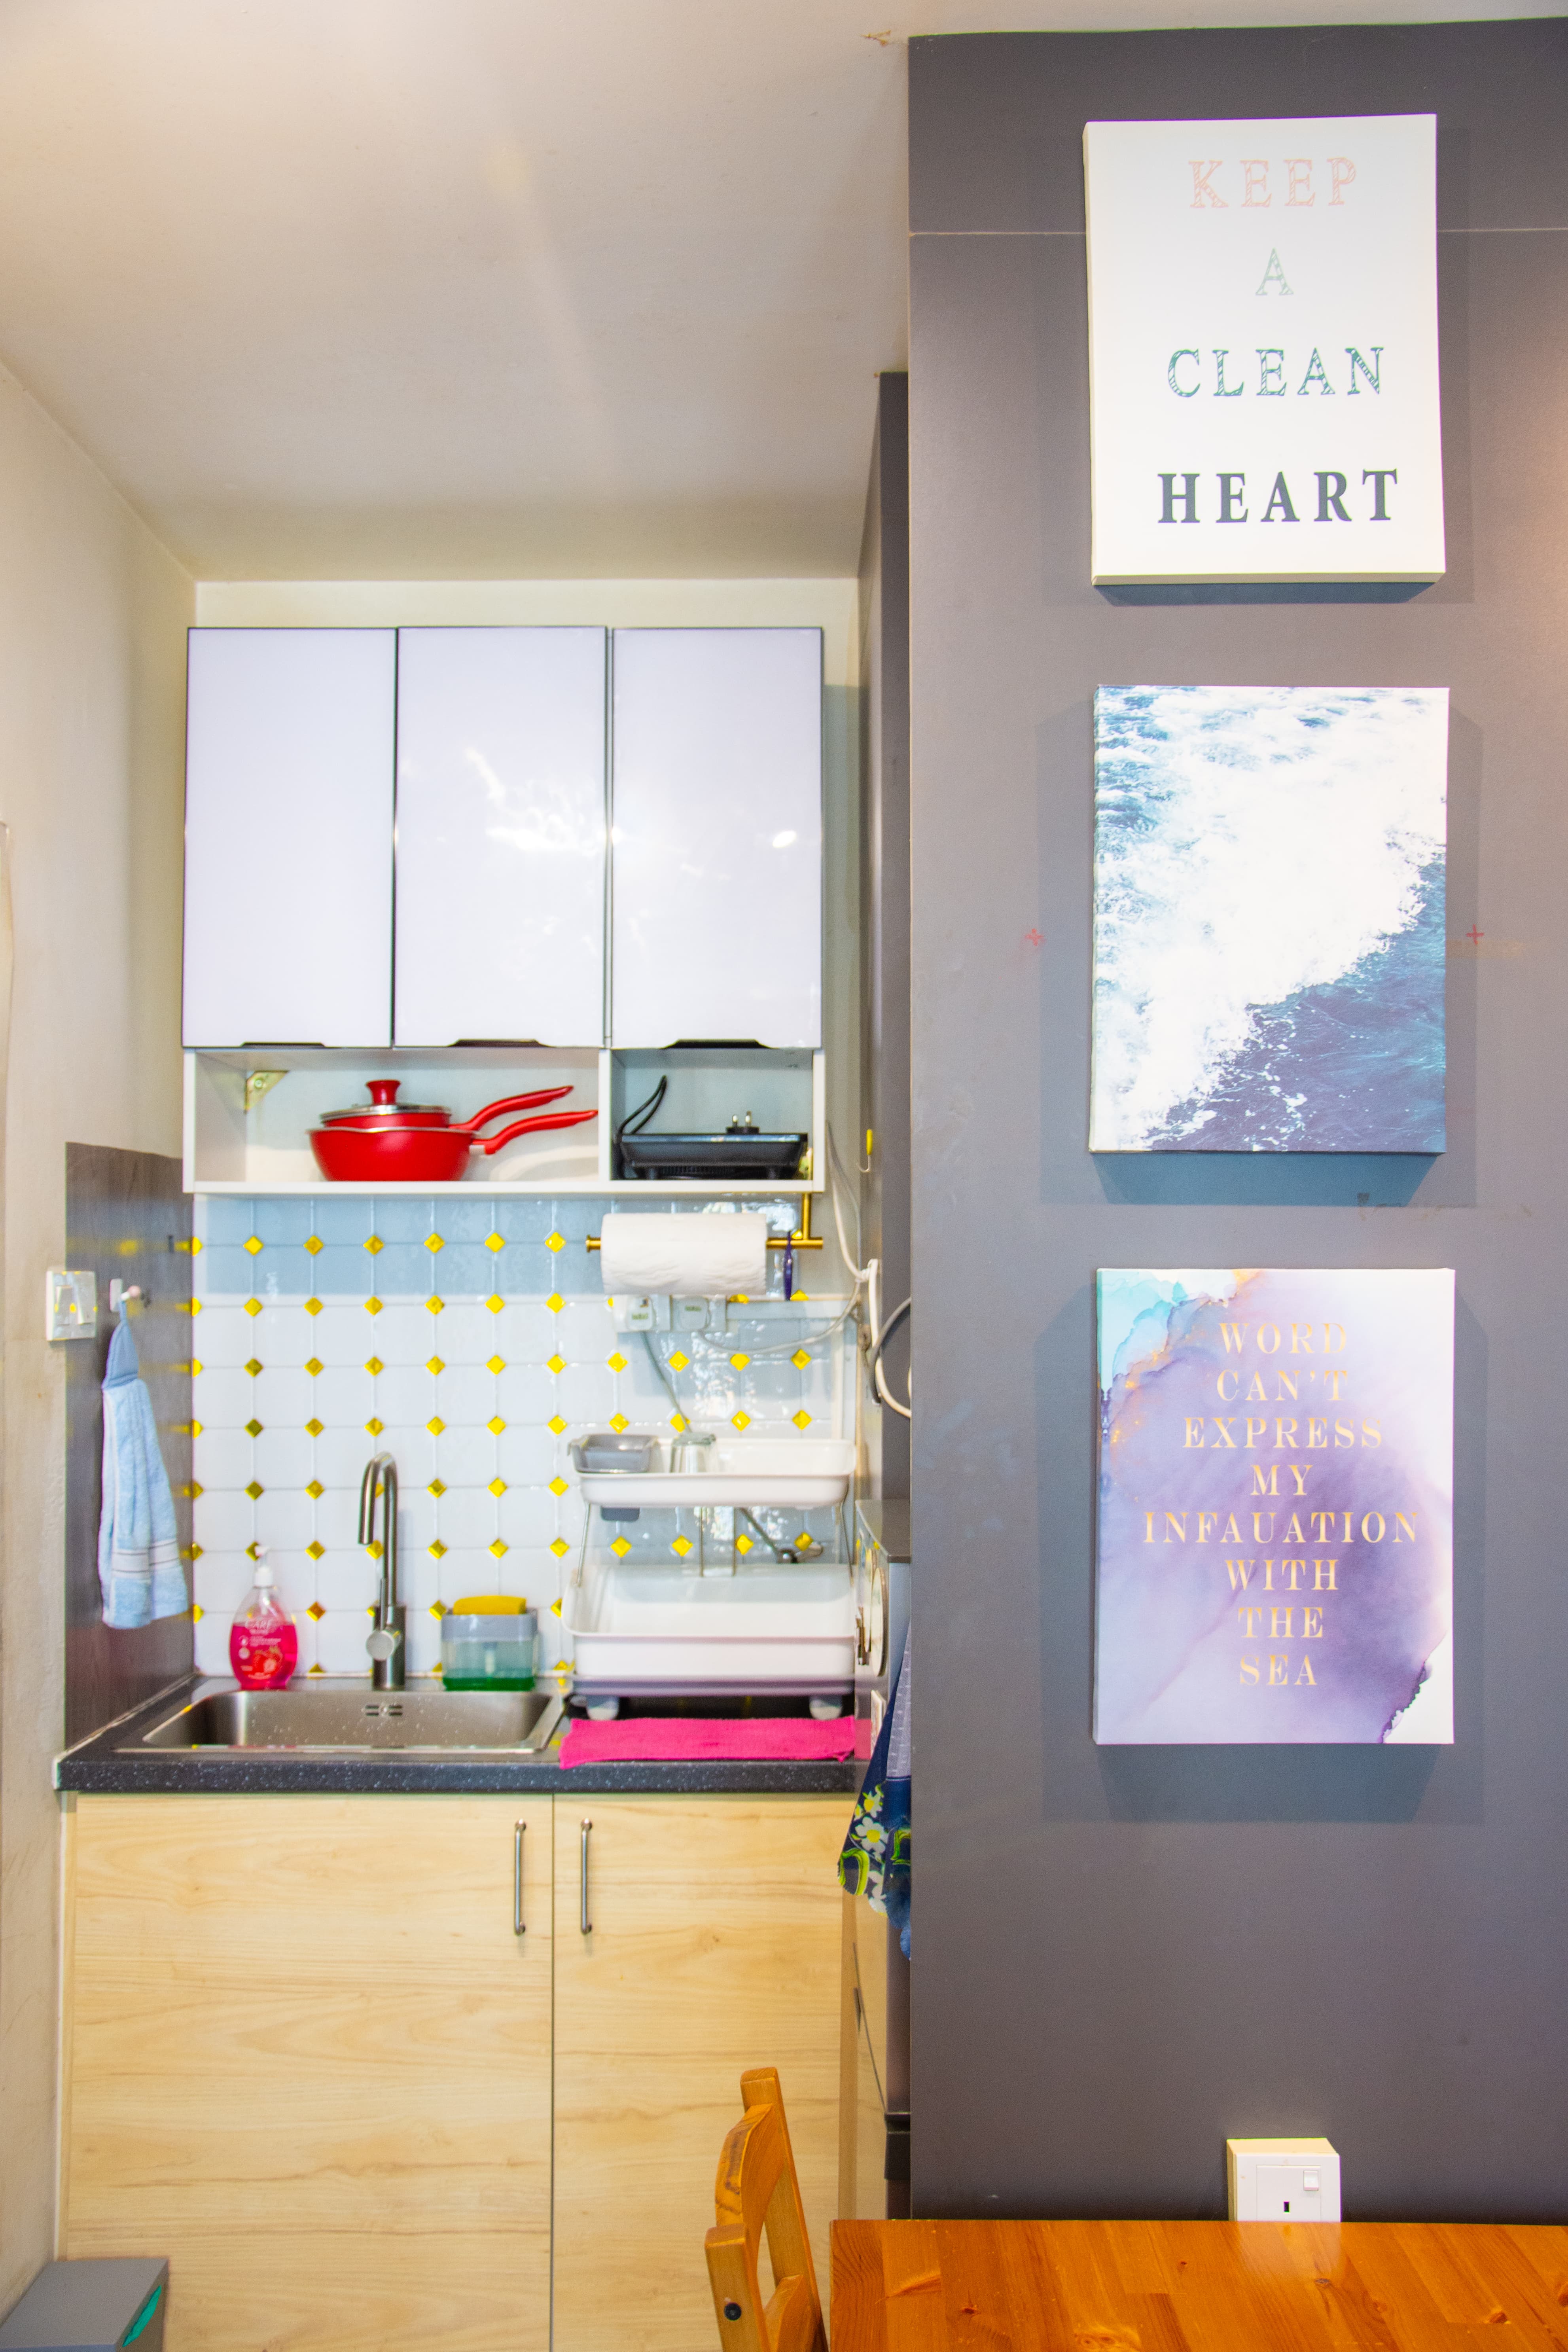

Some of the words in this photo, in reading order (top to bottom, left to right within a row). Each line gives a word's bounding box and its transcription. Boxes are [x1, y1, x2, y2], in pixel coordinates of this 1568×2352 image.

[1189, 157, 1356, 208] KEEP
[1256, 248, 1294, 295] A
[1167, 347, 1384, 398] CLEAN
[1157, 469, 1398, 523] HEART
[1219, 1322, 1347, 1354] WORD
[1216, 1370, 1348, 1401] CAN'T
[1182, 1417, 1382, 1449] EXPRESS
[1250, 1465, 1313, 1496] MY
[1143, 1511, 1419, 1544] INFAUATION
[1225, 1559, 1339, 1591] WITH
[1238, 1606, 1324, 1638] THE
[1239, 1654, 1318, 1686] SEA
